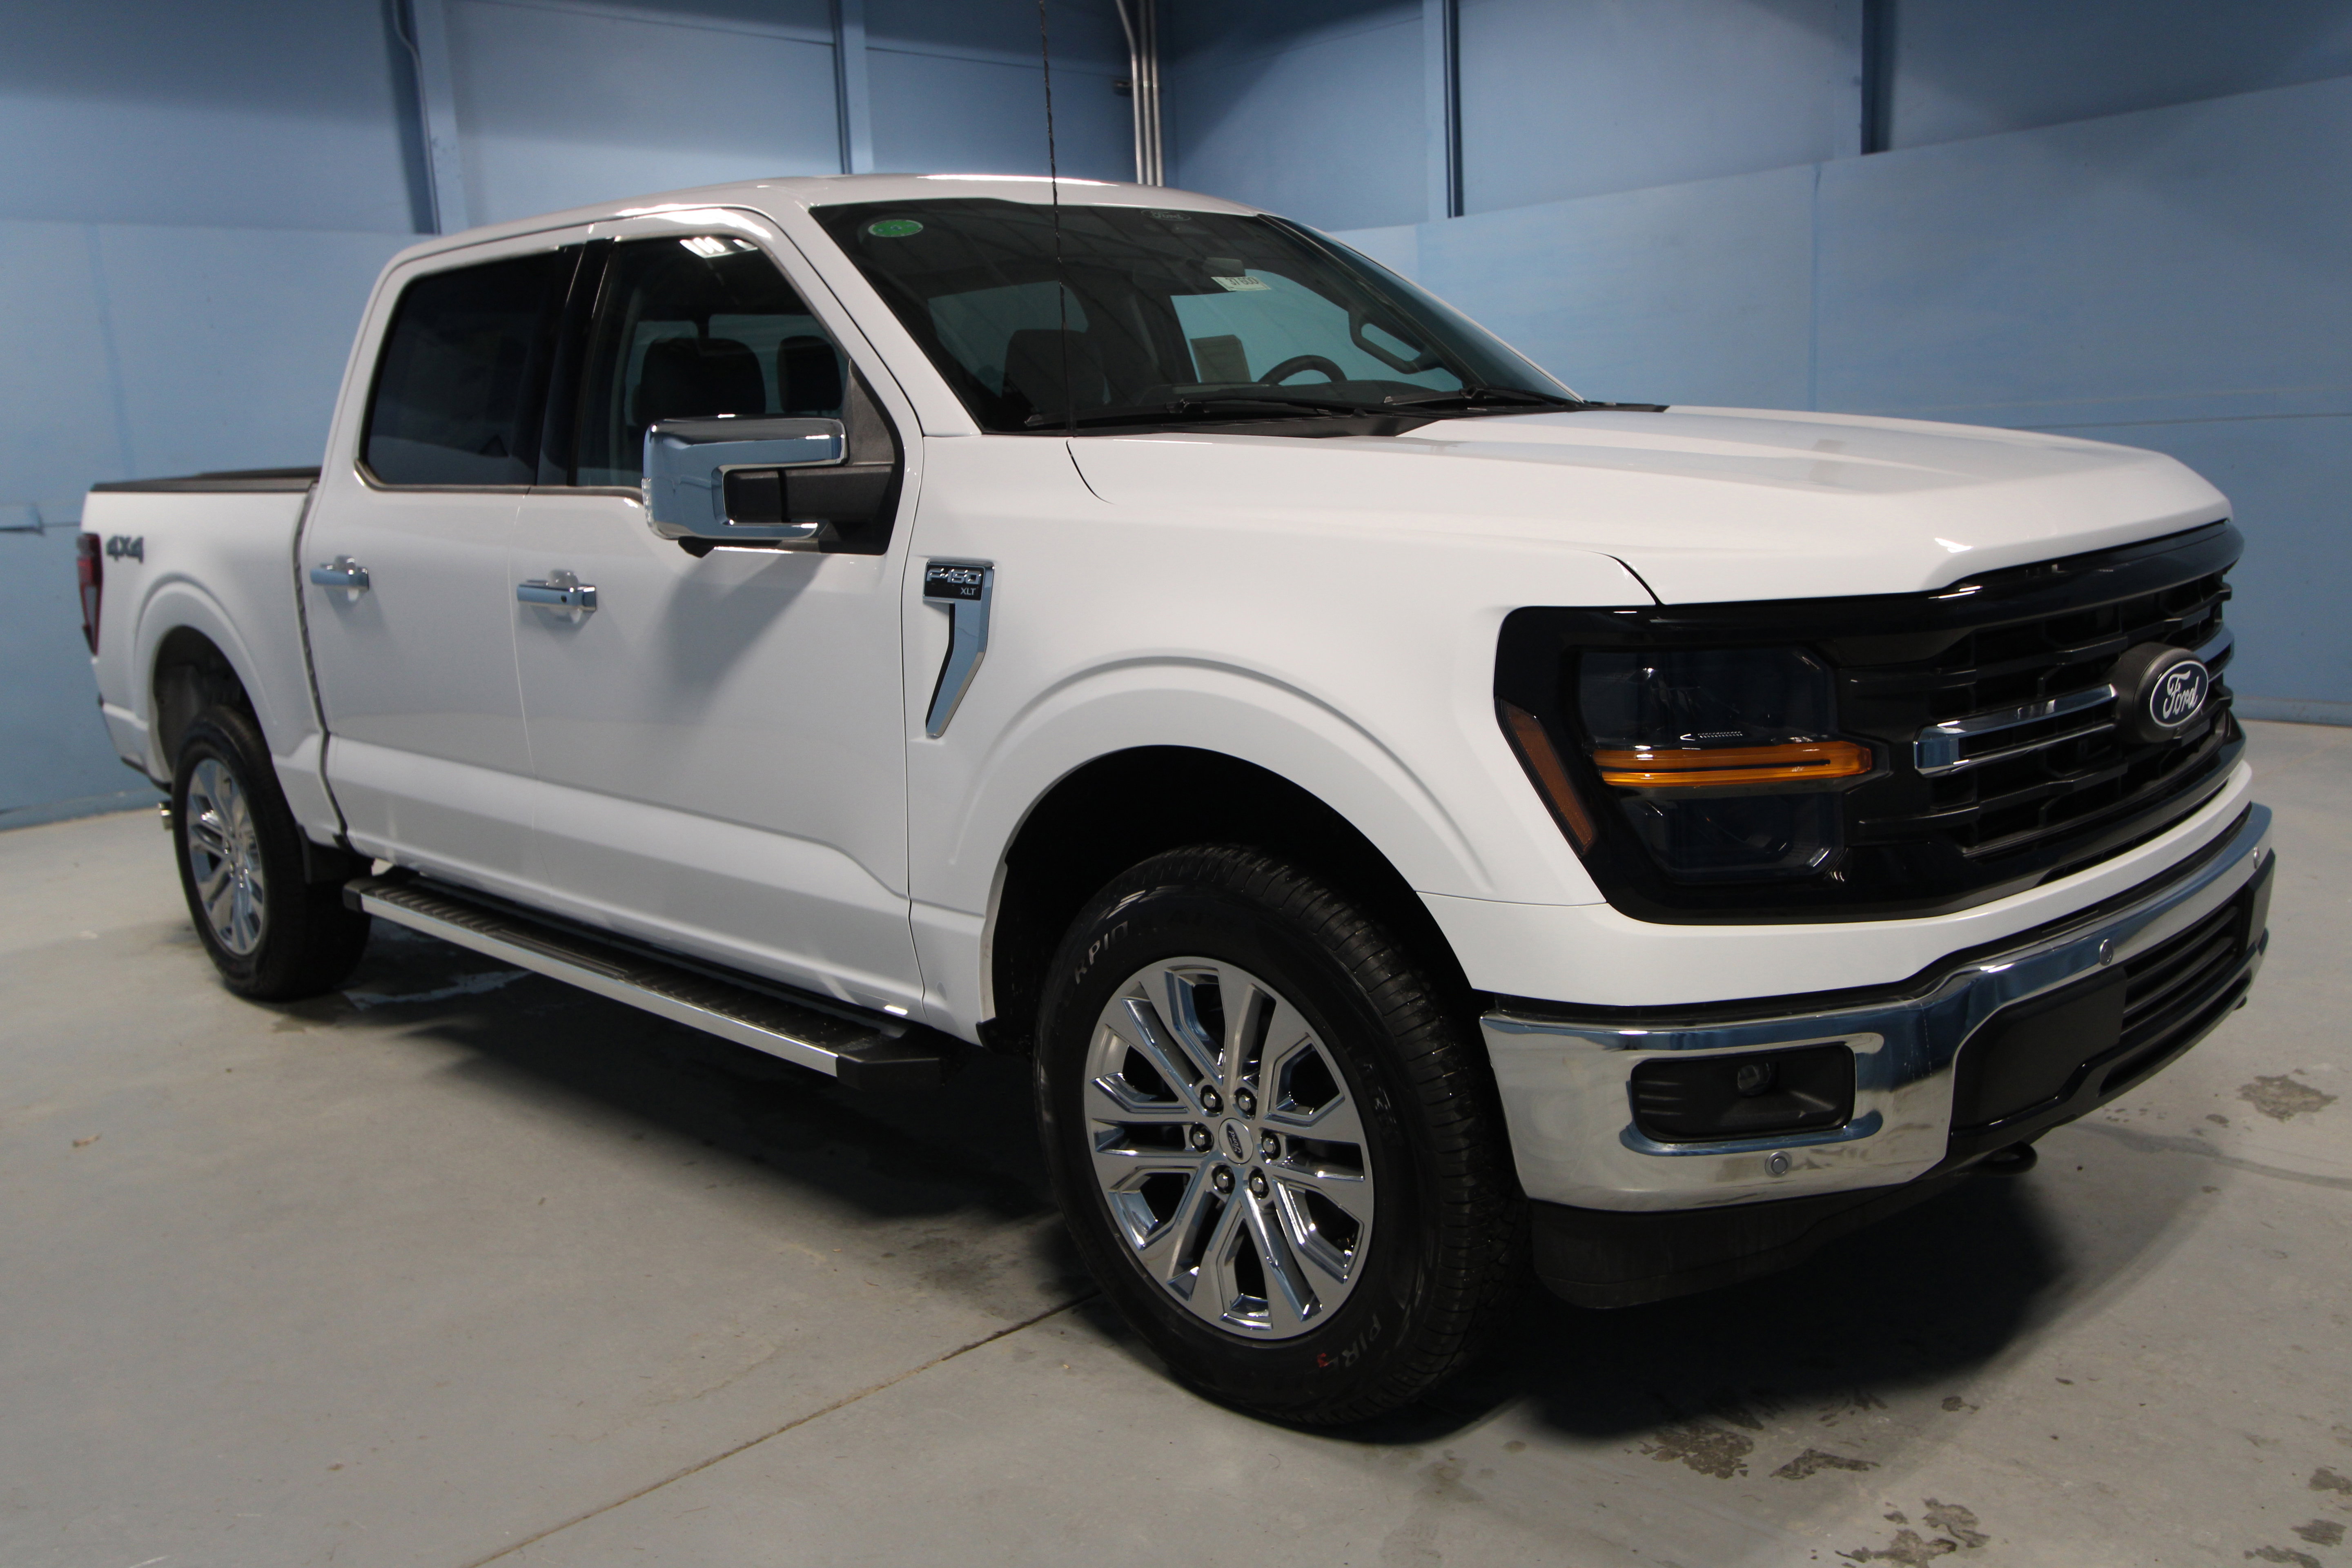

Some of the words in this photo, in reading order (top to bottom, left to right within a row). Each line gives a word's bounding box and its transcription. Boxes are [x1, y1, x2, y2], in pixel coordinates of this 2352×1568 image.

[1151, 211, 1183, 219] Ford
[927, 568, 980, 584] F-150
[2163, 670, 2199, 719] Ford
[1228, 1131, 1241, 1153] Ford
